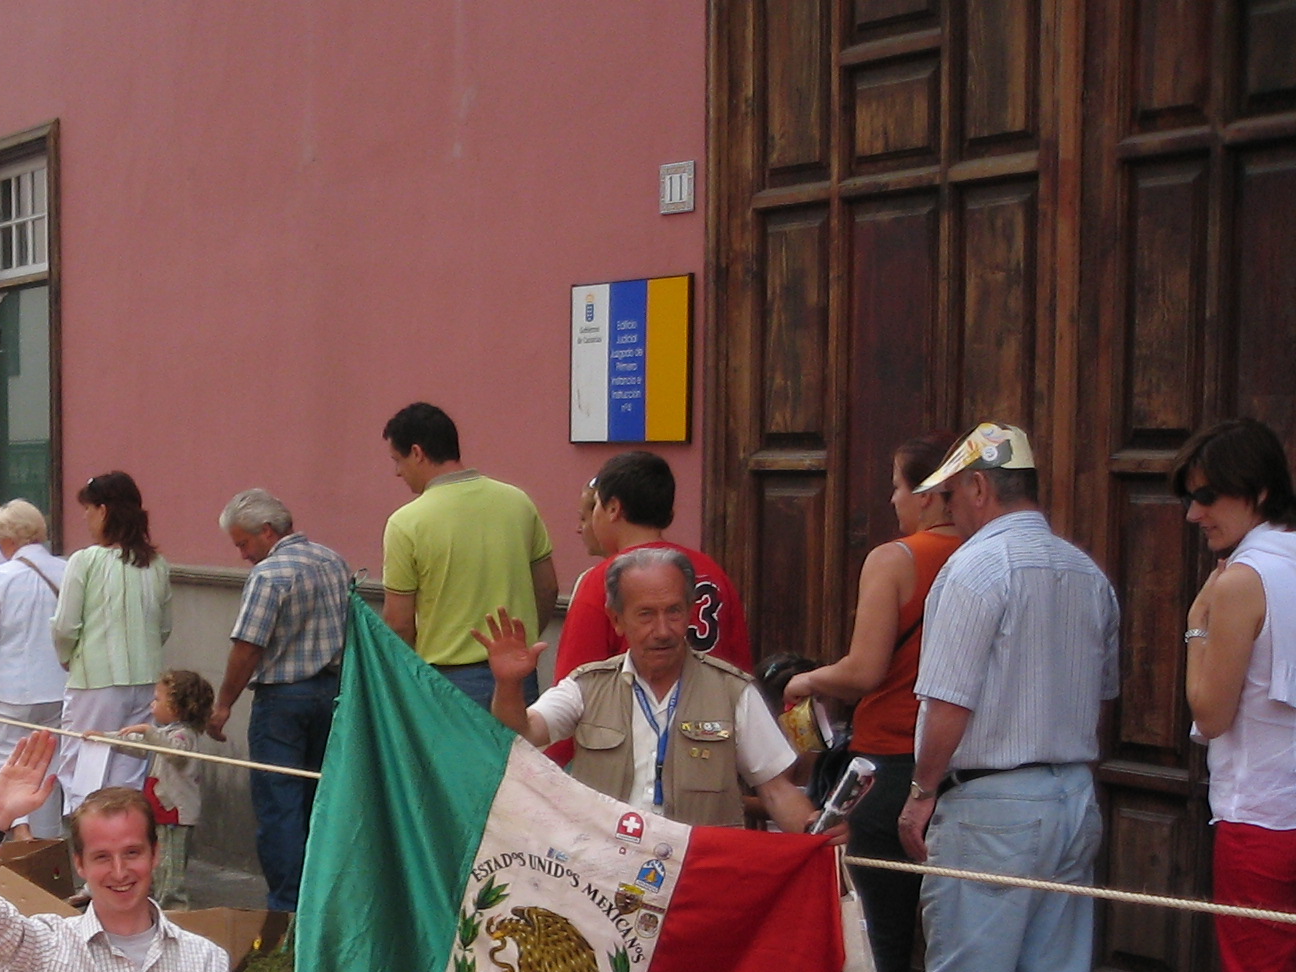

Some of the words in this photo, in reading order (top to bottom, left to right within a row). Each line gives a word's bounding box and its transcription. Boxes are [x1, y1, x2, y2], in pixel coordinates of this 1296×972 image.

[668, 174, 683, 202] 11
[616, 320, 638, 331] Edificio
[615, 334, 638, 344] Judicial
